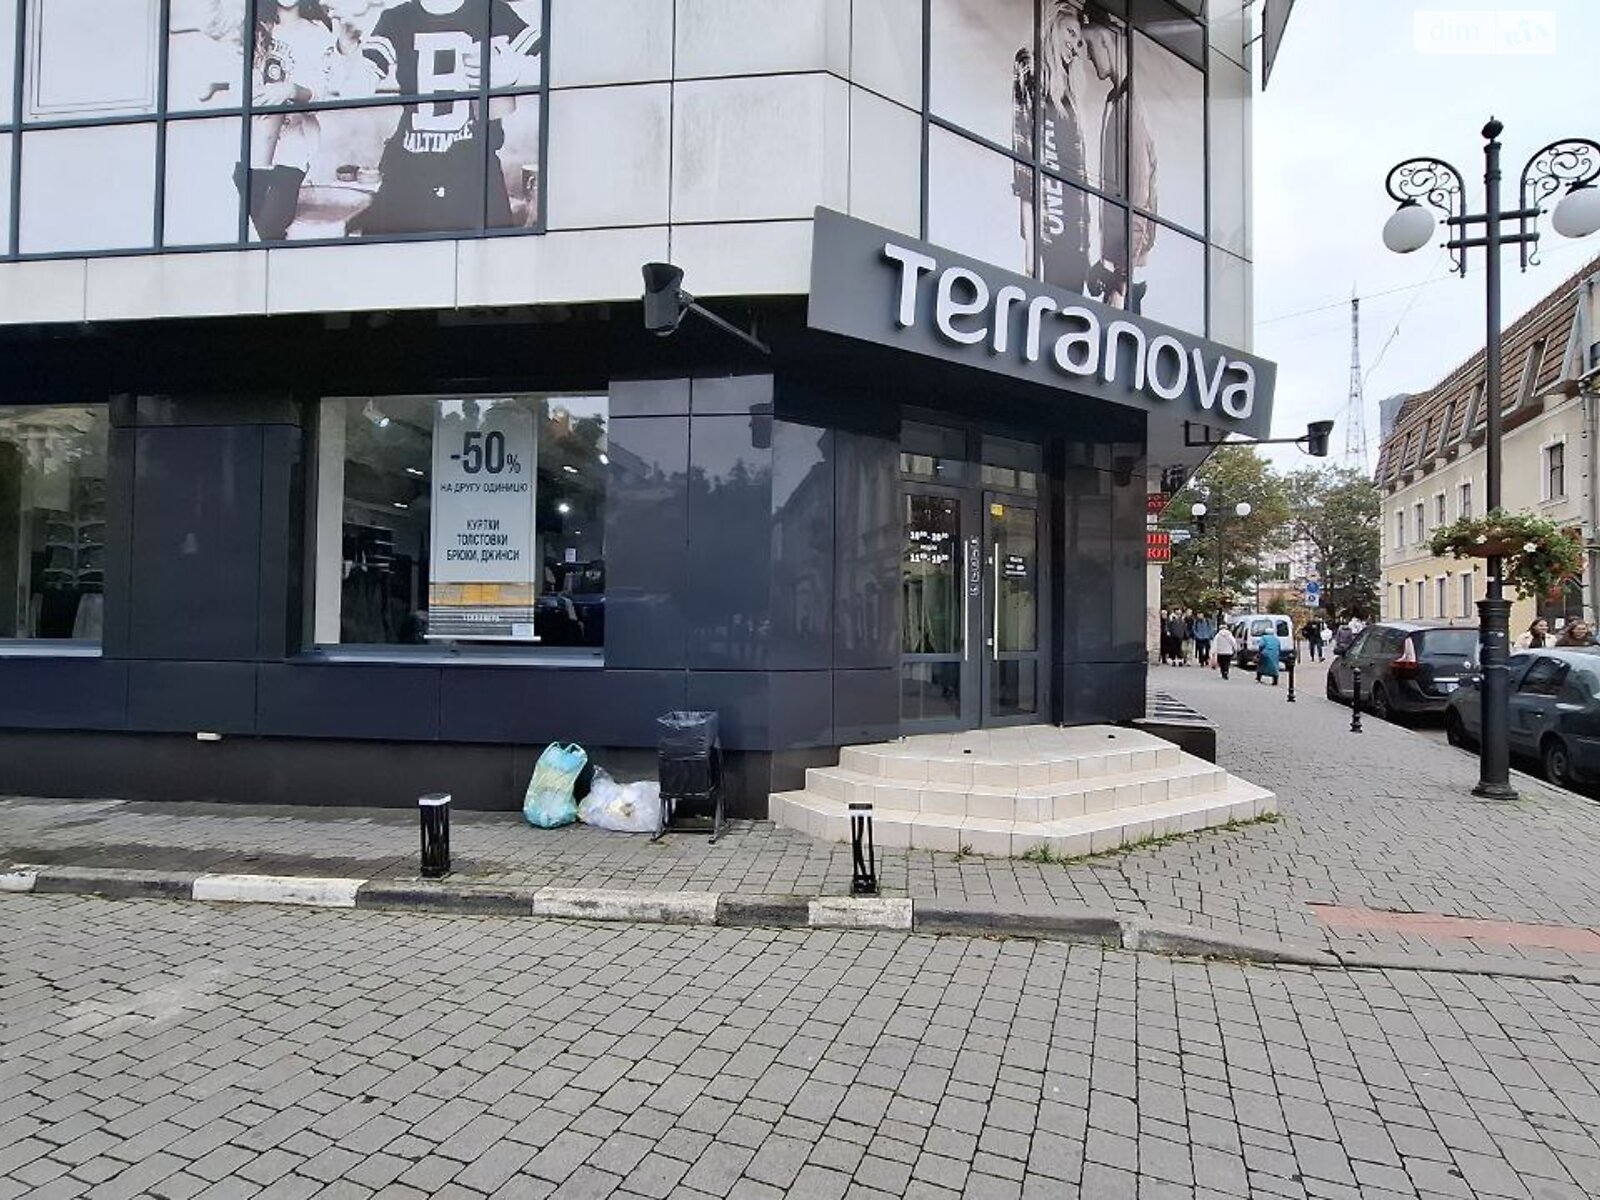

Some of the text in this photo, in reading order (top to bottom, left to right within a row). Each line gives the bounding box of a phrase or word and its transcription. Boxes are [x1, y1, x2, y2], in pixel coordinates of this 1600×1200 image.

[412, 33, 473, 131] B
[1046, 179, 1065, 234] ONE
[884, 243, 1256, 420] Terranova
[450, 431, 522, 474] -50%
[440, 482, 528, 494] НА ДРУГУ ОДИНИЦЮ
[466, 519, 500, 531] КУРТКИ
[457, 534, 508, 546] ТОЛСТОВКИ
[480, 550, 520, 563] ДЖИНСИ
